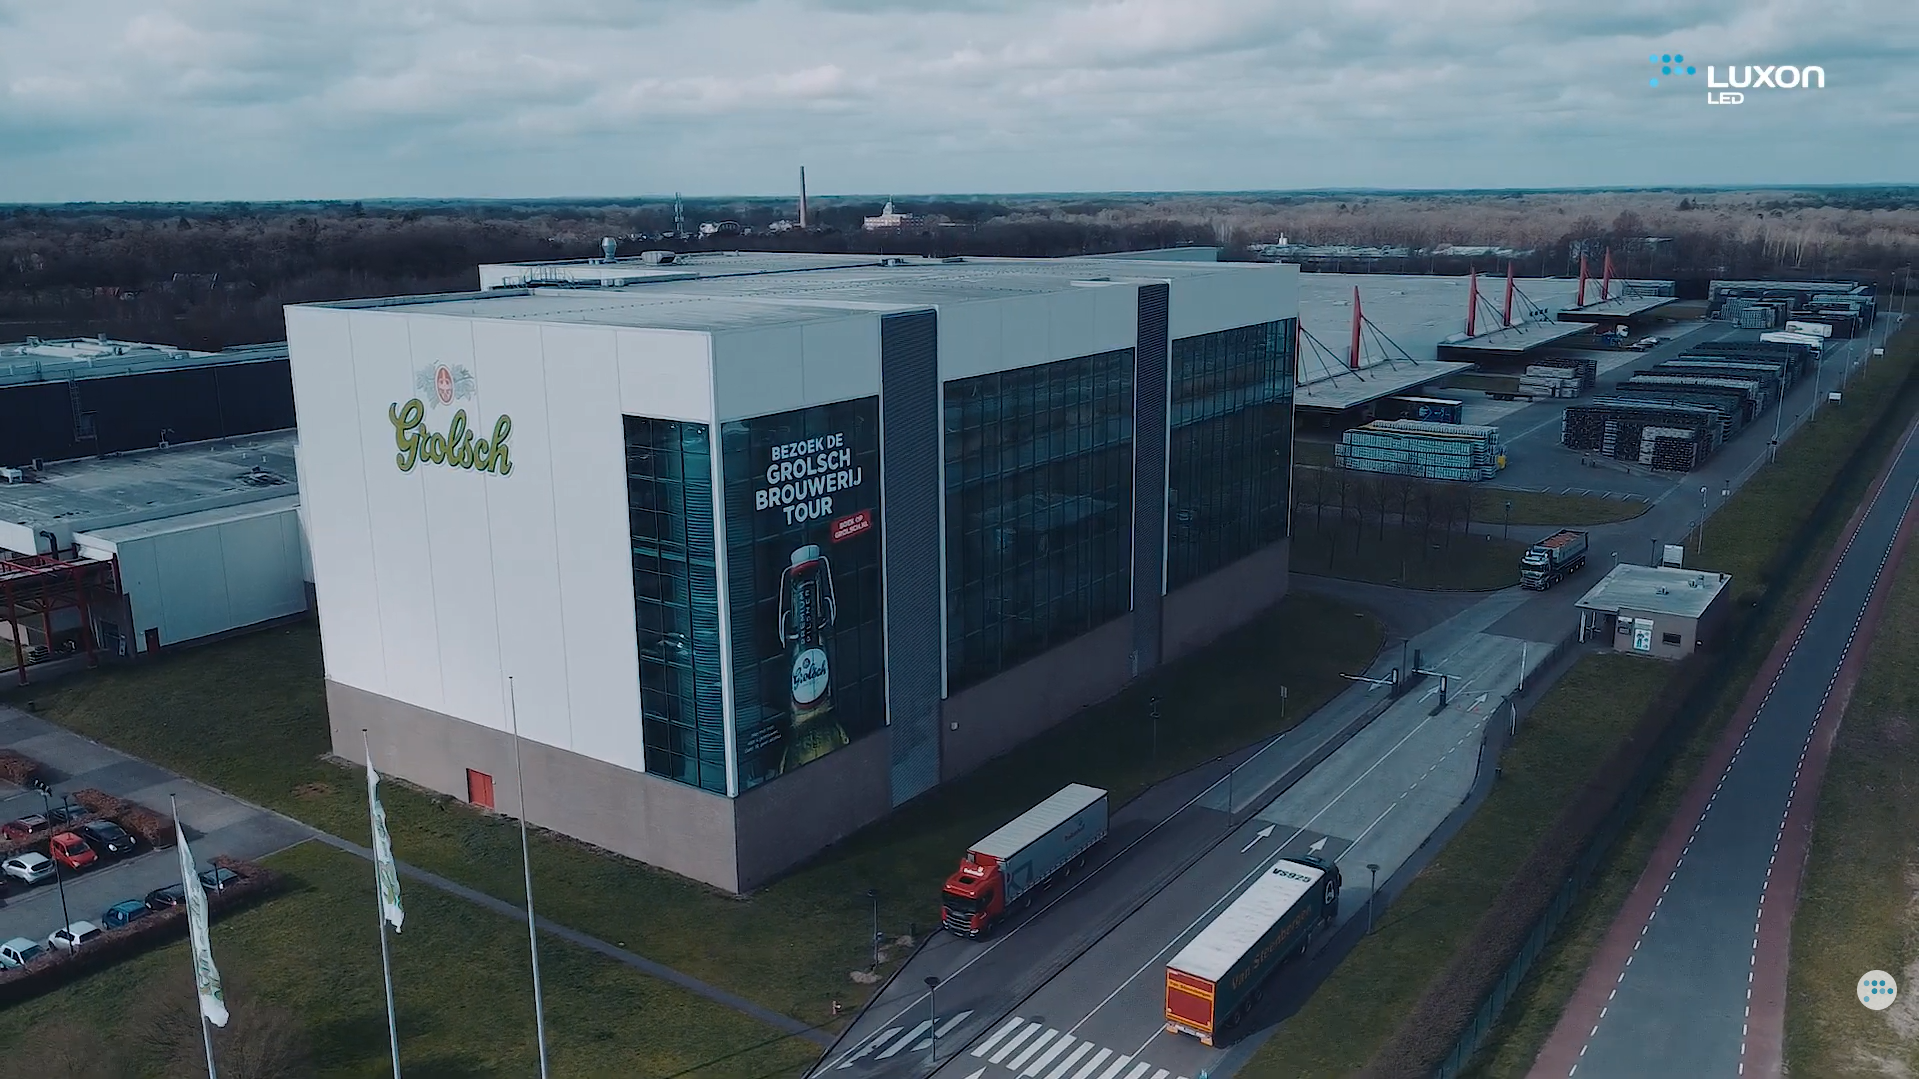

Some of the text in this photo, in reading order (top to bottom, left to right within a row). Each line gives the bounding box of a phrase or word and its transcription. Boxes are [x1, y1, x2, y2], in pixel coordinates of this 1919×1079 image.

[388, 397, 514, 477] Grolsch
[771, 432, 844, 461] BEZOEK DE
[766, 447, 851, 485] GROLSCH
[755, 466, 862, 511] BROUWERIJ
[782, 496, 833, 526] TOUR
[792, 657, 827, 690] Grolsch
[1272, 867, 1313, 883] VS925
